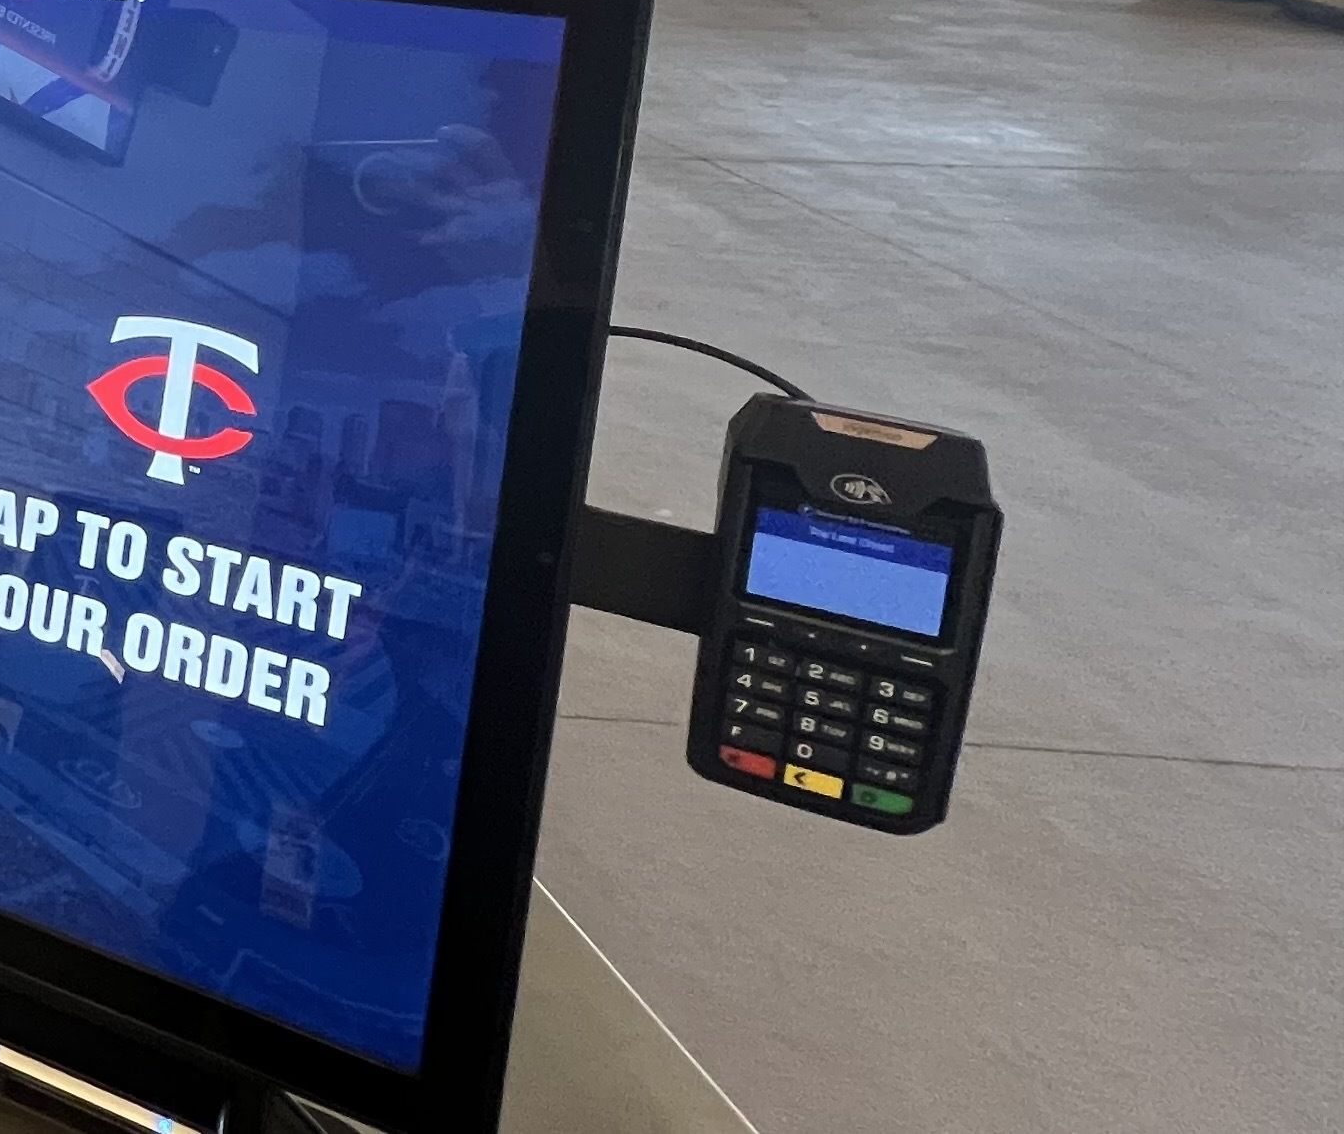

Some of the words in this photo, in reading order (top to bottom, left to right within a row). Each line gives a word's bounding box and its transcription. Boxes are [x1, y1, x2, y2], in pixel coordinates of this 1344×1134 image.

[75, 509, 148, 582] TO
[162, 537, 364, 641] START
[744, 647, 755, 662] 1
[123, 613, 331, 729] ORDER
[808, 663, 825, 680] 2
[736, 673, 753, 688] 4
[878, 681, 895, 698] 3
[734, 698, 749, 713] 7
[804, 691, 820, 706] 5
[872, 708, 889, 724] 6
[800, 717, 816, 733] 8
[868, 735, 885, 751] 9
